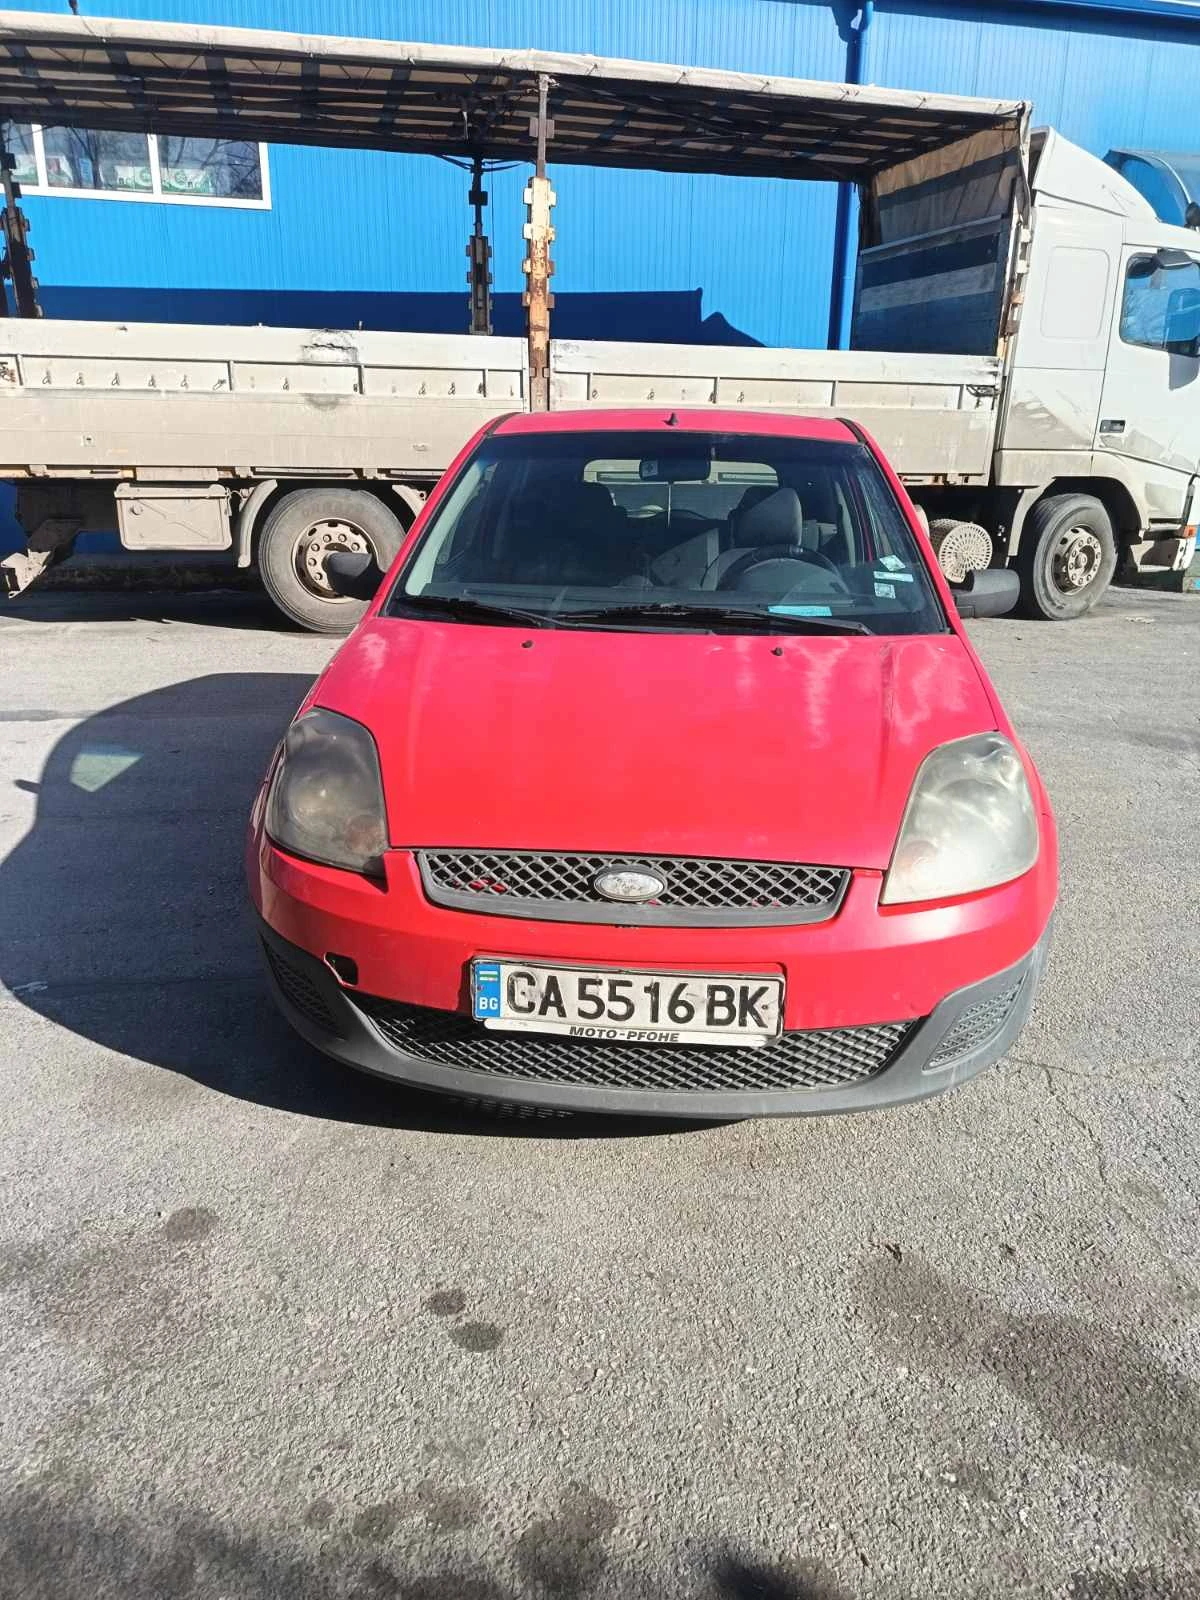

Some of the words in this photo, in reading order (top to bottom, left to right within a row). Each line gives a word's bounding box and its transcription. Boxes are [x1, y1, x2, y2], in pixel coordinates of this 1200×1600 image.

[479, 997, 498, 1010] BG
[507, 971, 567, 1018] CA
[577, 977, 695, 1024] 5516
[706, 984, 769, 1028] BK
[569, 1026, 680, 1042] MOTO-PFOHE
